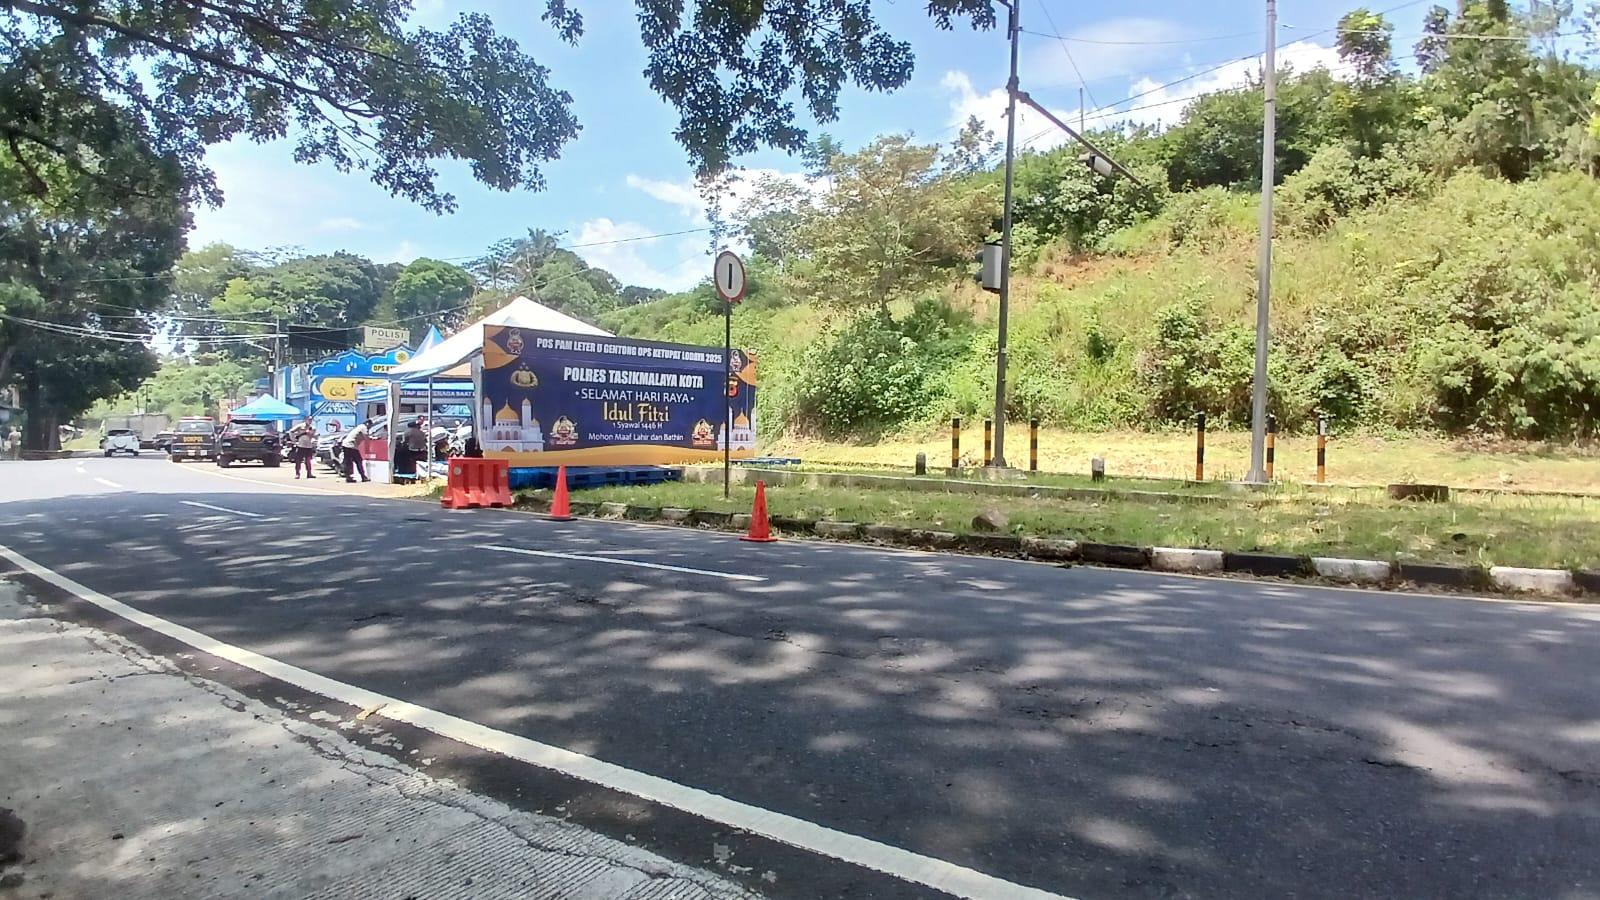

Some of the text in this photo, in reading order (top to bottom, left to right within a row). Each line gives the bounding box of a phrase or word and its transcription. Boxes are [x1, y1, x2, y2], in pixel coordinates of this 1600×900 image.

[371, 329, 404, 339] POLISI
[536, 338, 554, 349] POS
[555, 340, 573, 350] PAM
[574, 341, 596, 352] LETER
[604, 344, 637, 356] GENTONG
[638, 347, 653, 357] OPS
[653, 348, 682, 360] KETUPAT
[706, 353, 722, 363] 2025
[564, 366, 704, 389] POLRES TASIKMALAYA KOTA
[581, 388, 690, 403] SELAMAT HARI RAYA
[603, 401, 669, 422] Idul Fitri
[617, 421, 640, 430] Syawal
[641, 422, 656, 430] 1446
[588, 433, 614, 441] Mohon
[615, 433, 632, 441] Maaf
[633, 433, 650, 441] Lahir
